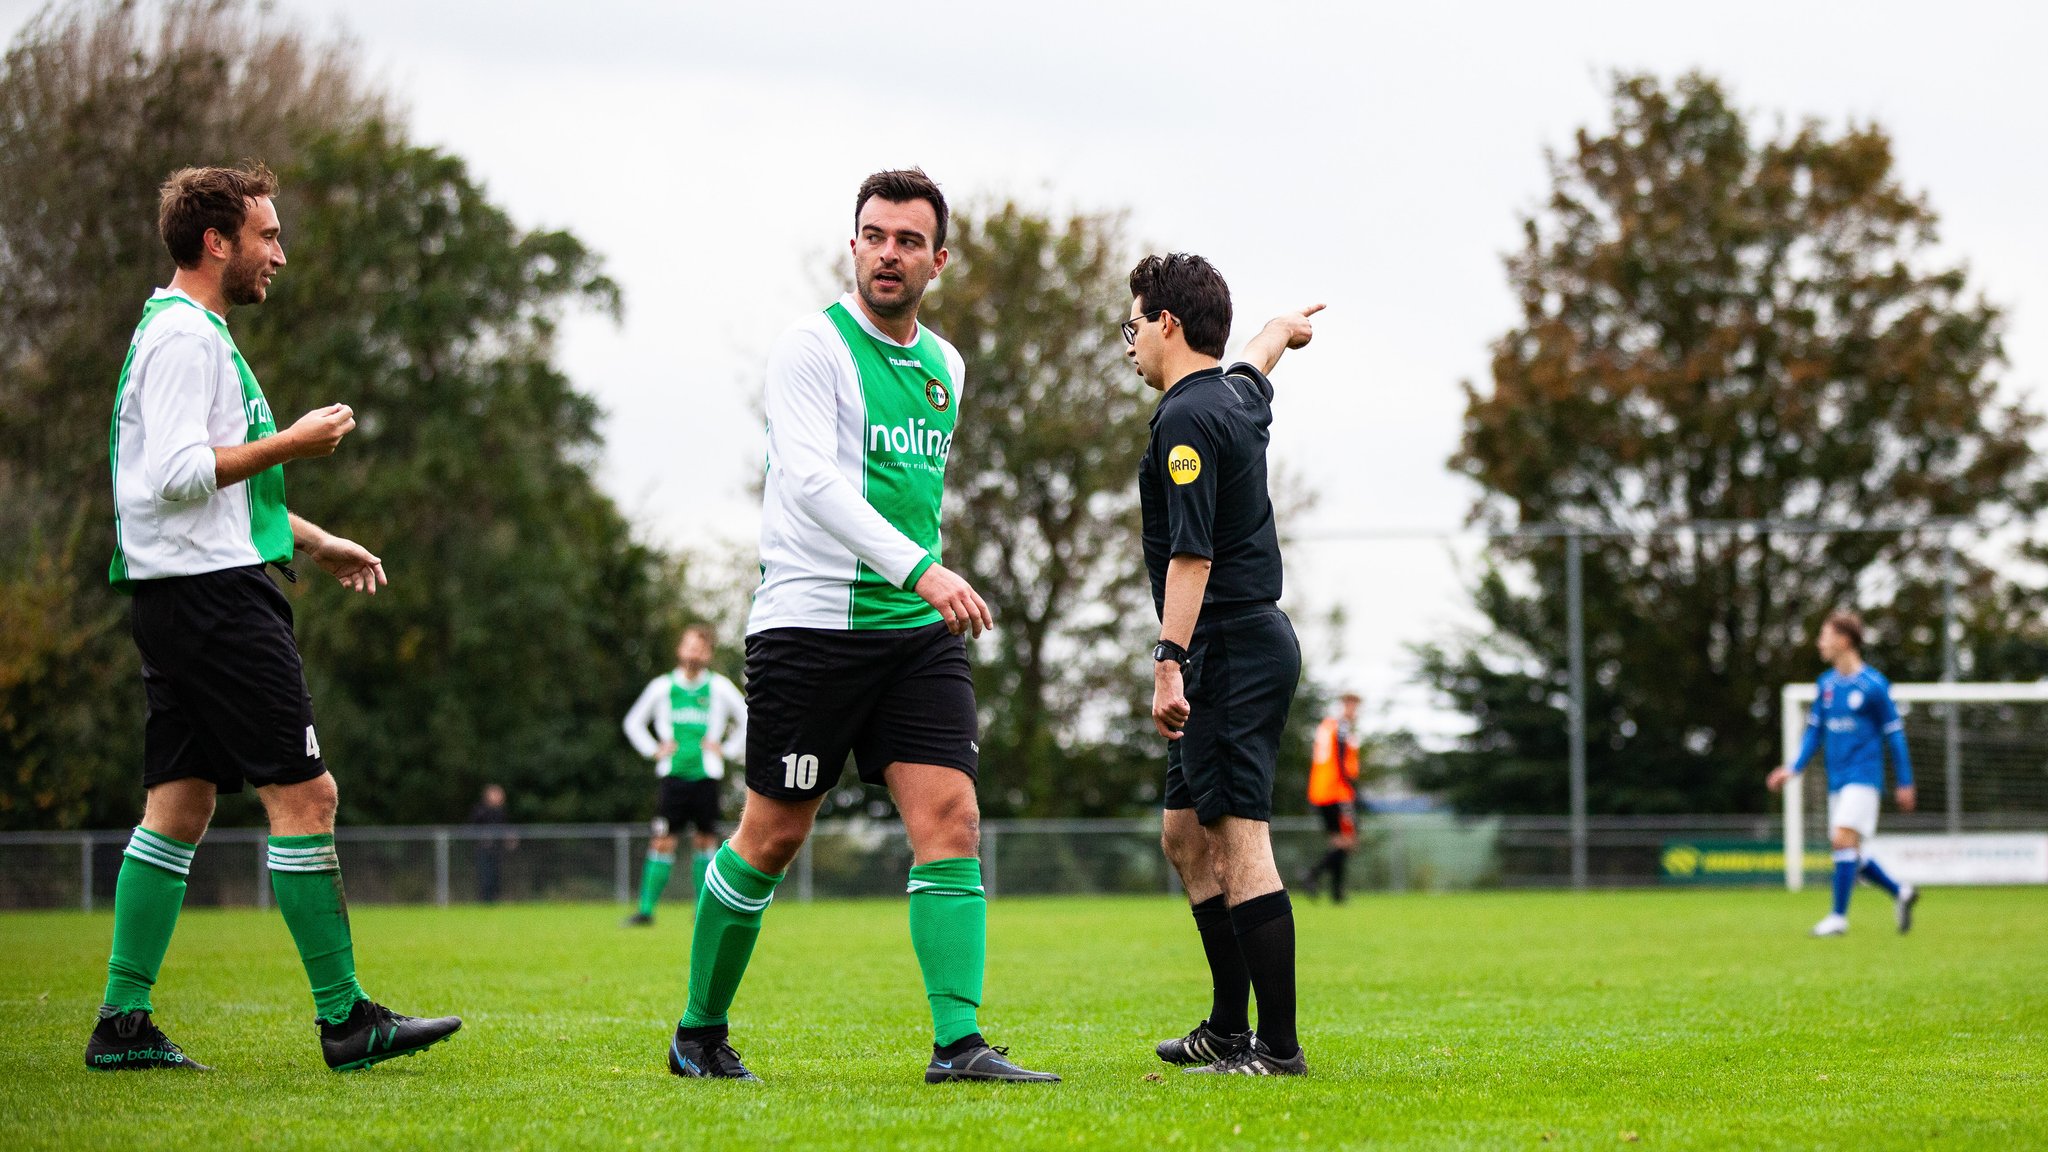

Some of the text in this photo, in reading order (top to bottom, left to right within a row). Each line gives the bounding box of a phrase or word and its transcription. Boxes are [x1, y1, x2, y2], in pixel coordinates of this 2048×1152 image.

[1171, 458, 1197, 473] ARAG
[306, 724, 320, 759] 4
[782, 753, 819, 790] 10
[94, 1047, 184, 1064] new balance
